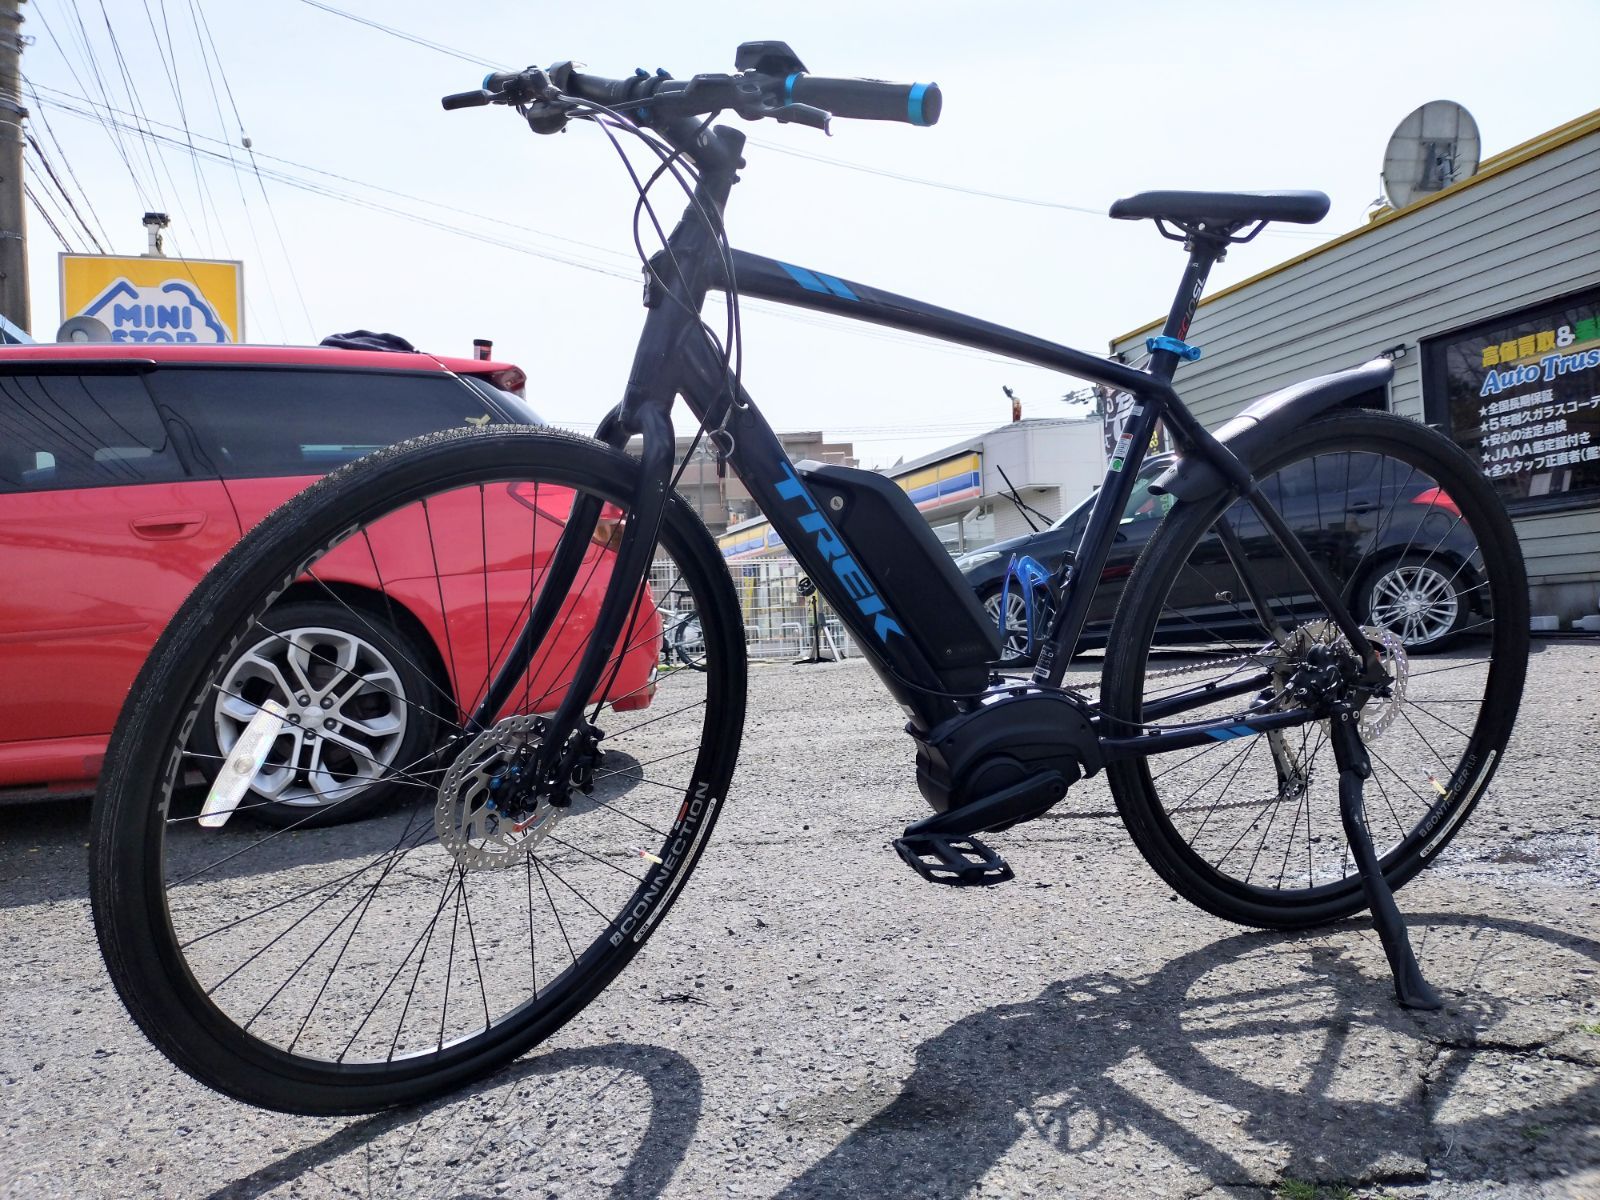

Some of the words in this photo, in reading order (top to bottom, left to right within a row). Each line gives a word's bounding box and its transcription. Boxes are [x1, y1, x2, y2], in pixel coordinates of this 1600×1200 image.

[113, 303, 192, 330] MINI
[1480, 364, 1541, 397] Auto
[1488, 418, 1568, 447] 安心の法定点検
[773, 460, 905, 644] TREK
[619, 781, 710, 936] CONNECTION
